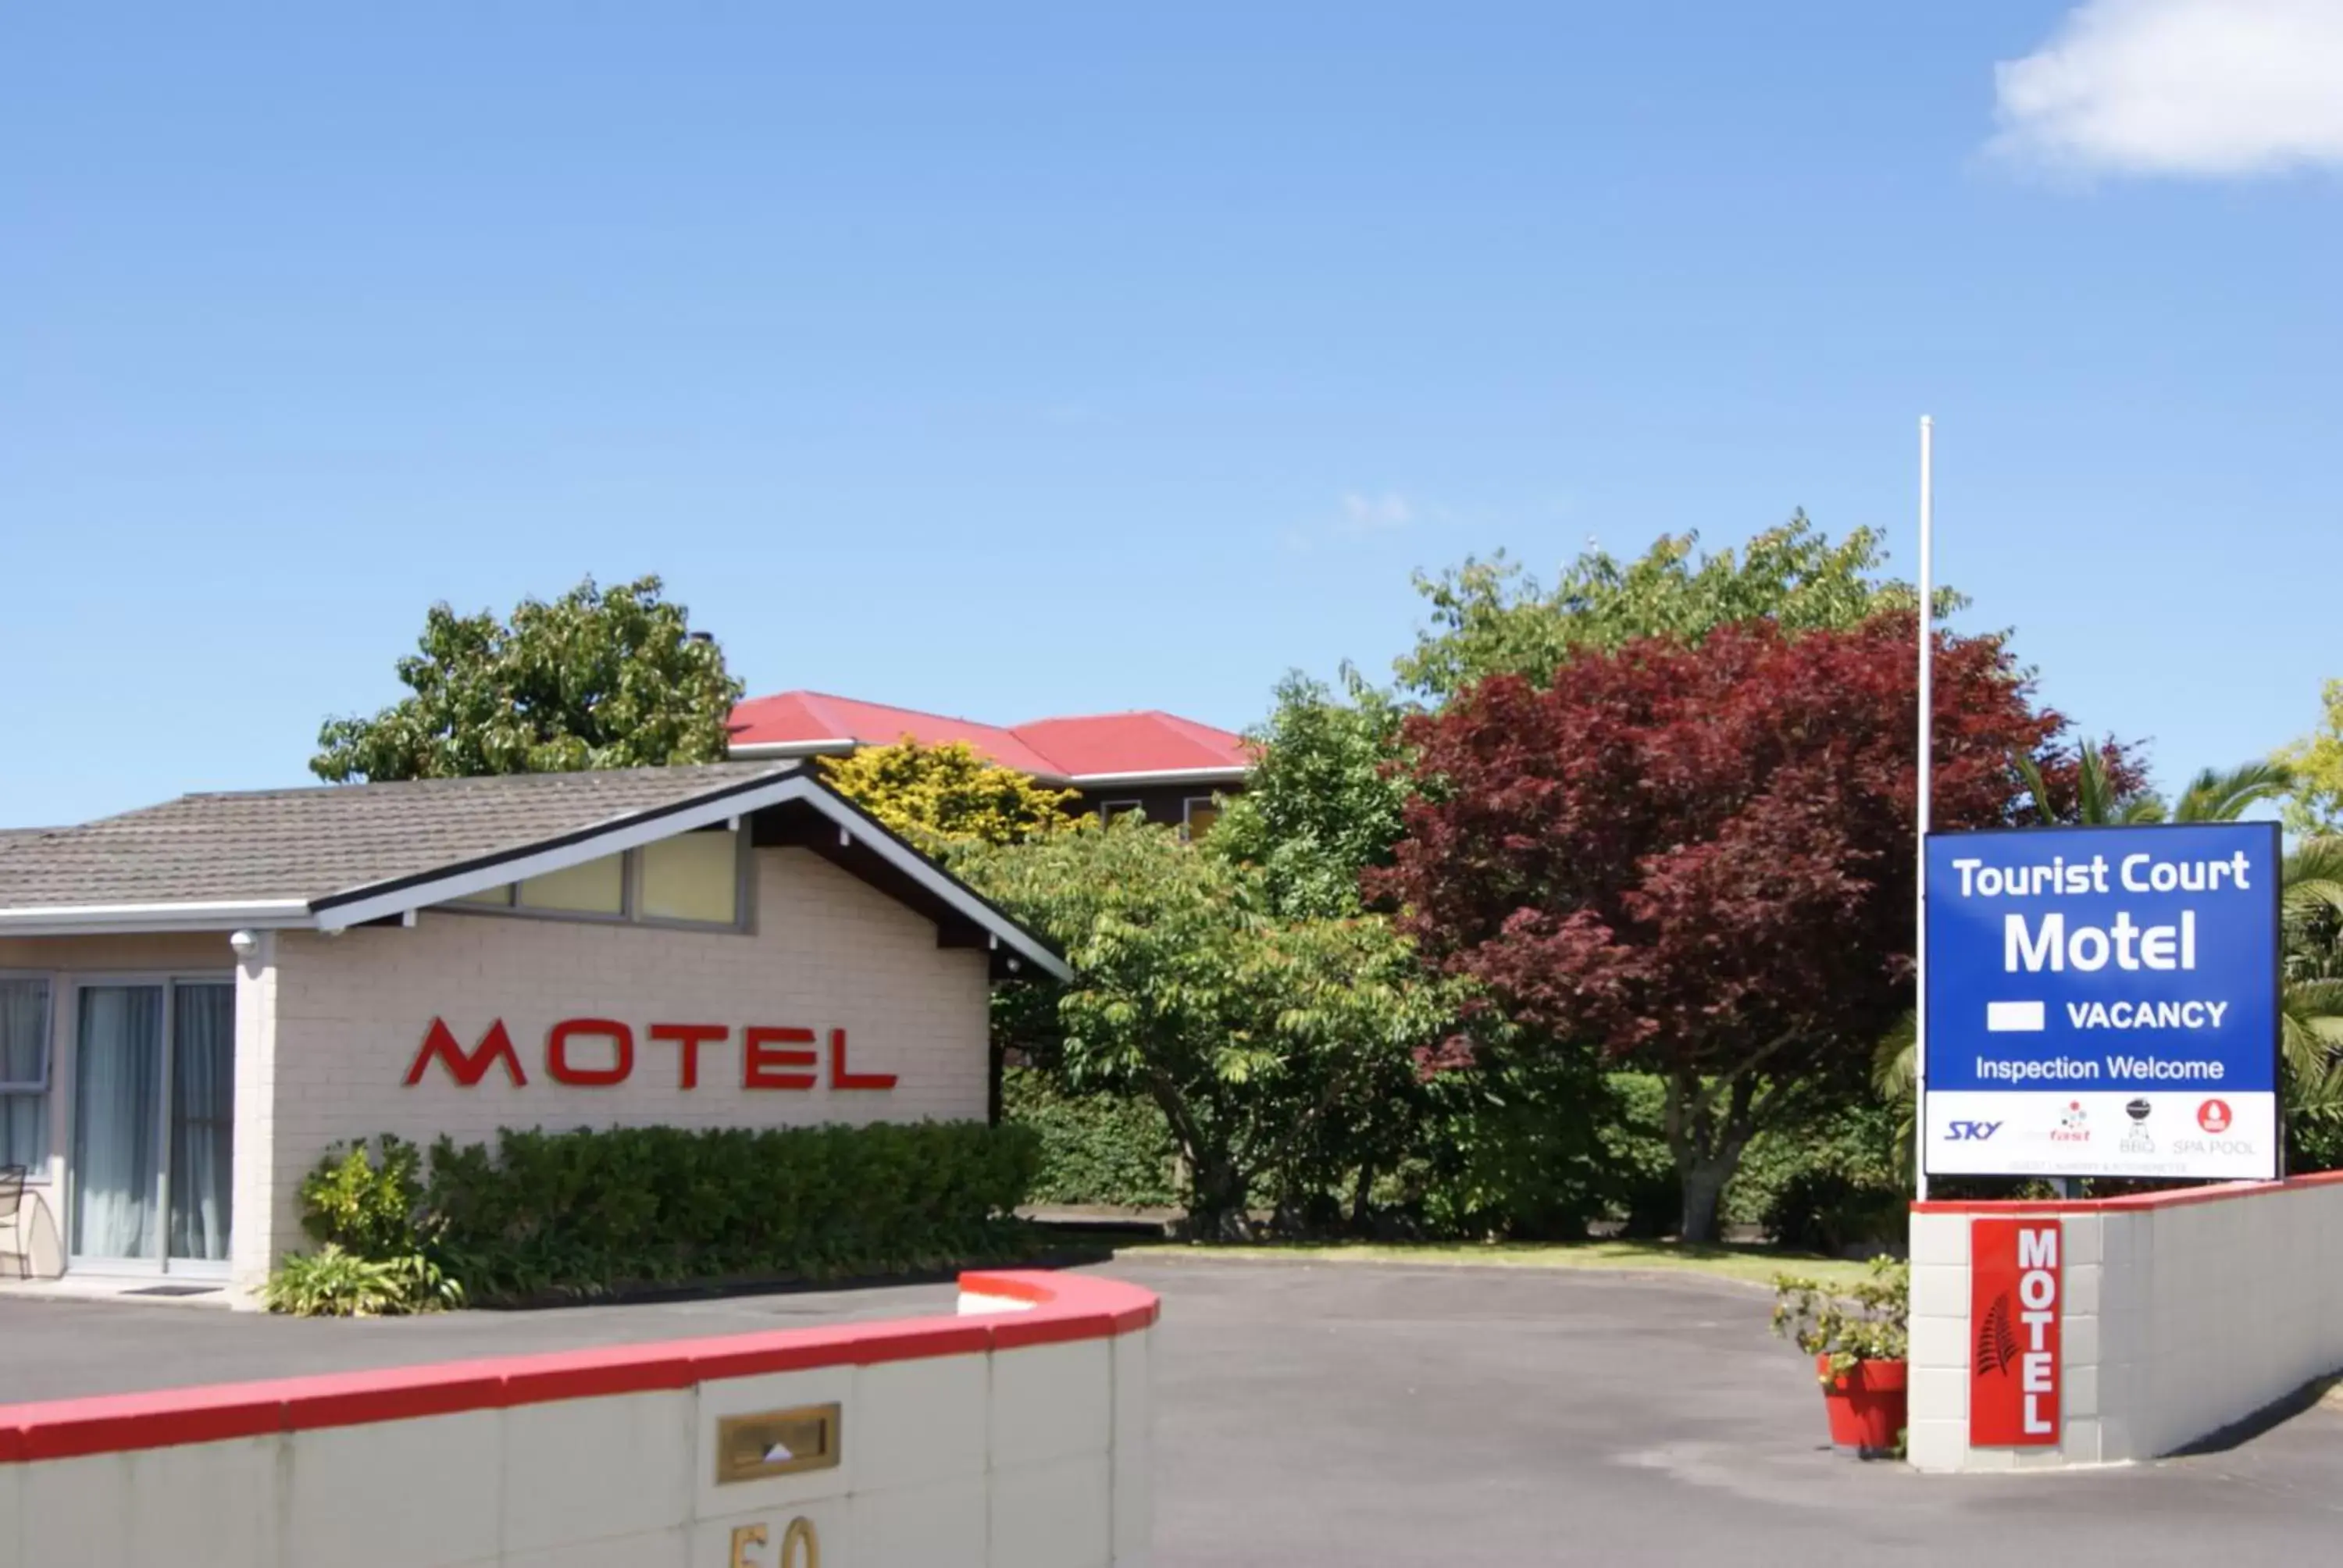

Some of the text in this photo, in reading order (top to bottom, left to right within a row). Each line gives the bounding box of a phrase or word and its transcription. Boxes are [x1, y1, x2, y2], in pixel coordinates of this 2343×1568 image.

[1952, 850, 2250, 897] Tourist Court
[2005, 910, 2195, 972] Motel
[2067, 1000, 2228, 1029] VACANCY
[403, 1016, 897, 1089] MOTEL
[1977, 1056, 2224, 1083] Inspection Welcome
[1944, 1121, 2003, 1141] SKY
[2120, 1139, 2156, 1153] BBQ
[2173, 1140, 2256, 1155] SPA POOL
[2018, 1228, 2057, 1434] MOTEL
